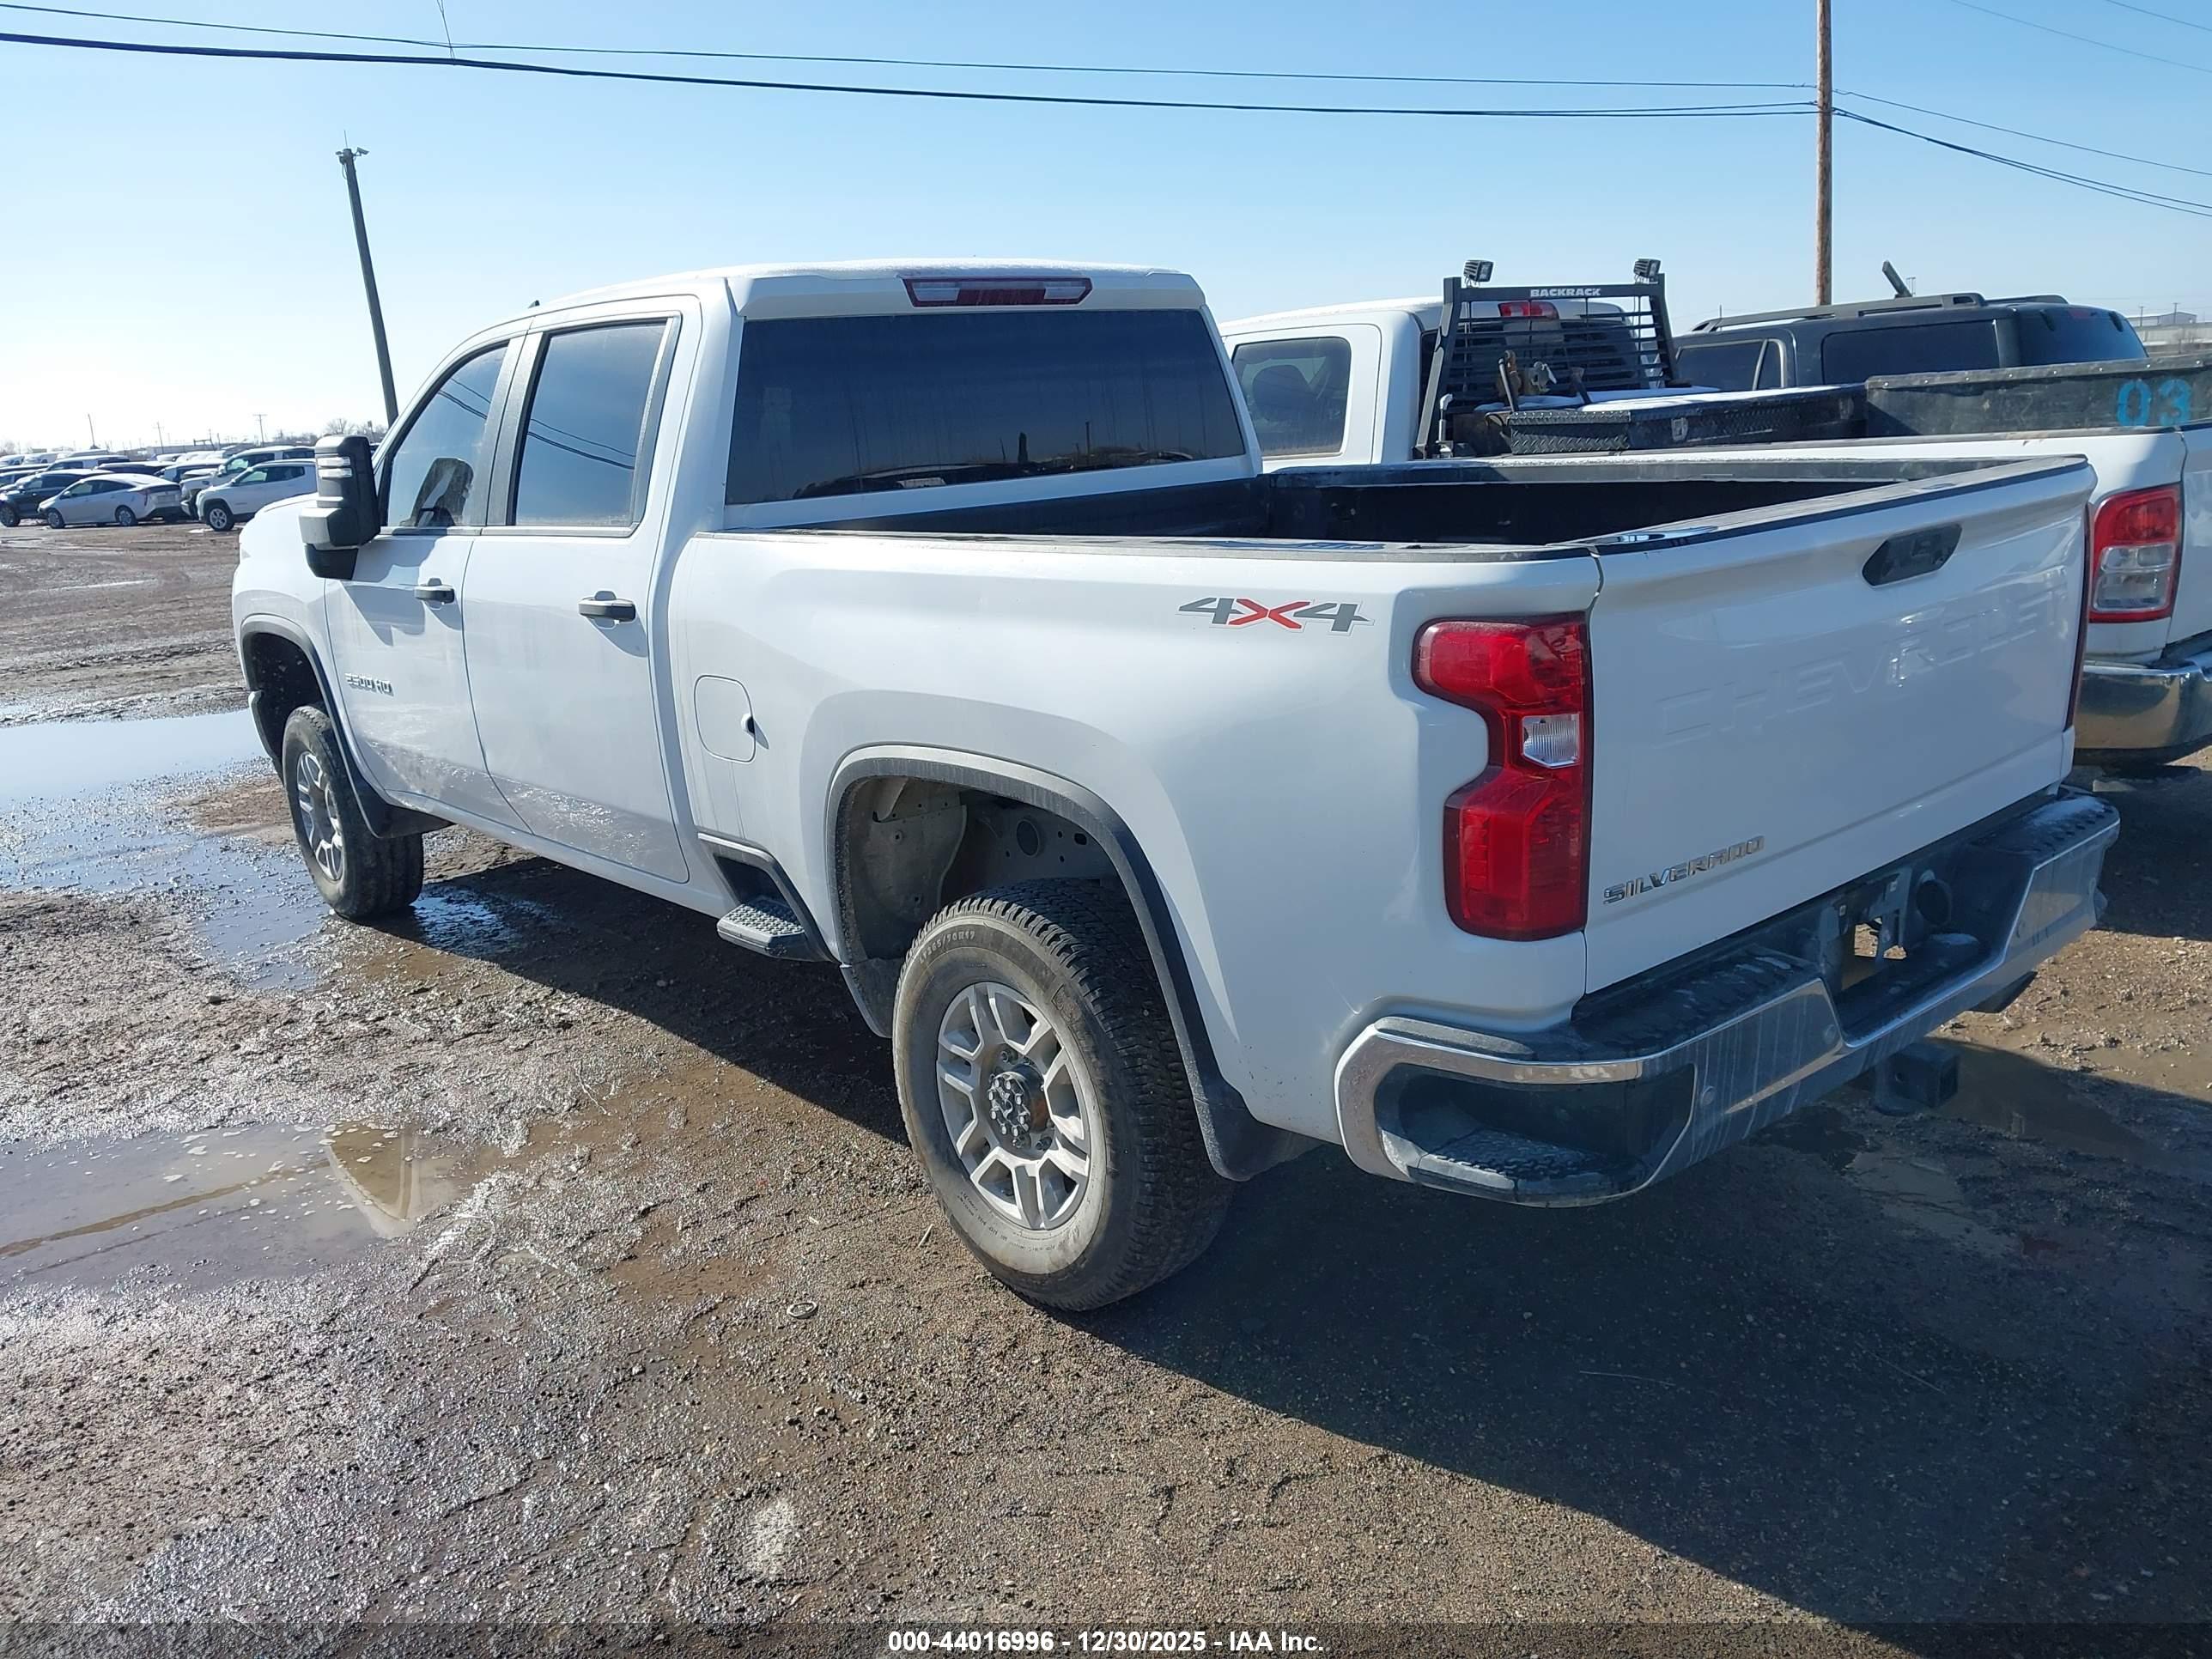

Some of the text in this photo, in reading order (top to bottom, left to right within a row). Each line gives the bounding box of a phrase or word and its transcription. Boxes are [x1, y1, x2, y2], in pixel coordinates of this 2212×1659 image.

[1530, 288, 1601, 297] BACKRACK
[2116, 377, 2192, 428] 03
[1603, 836, 1765, 904] SILVERADO
